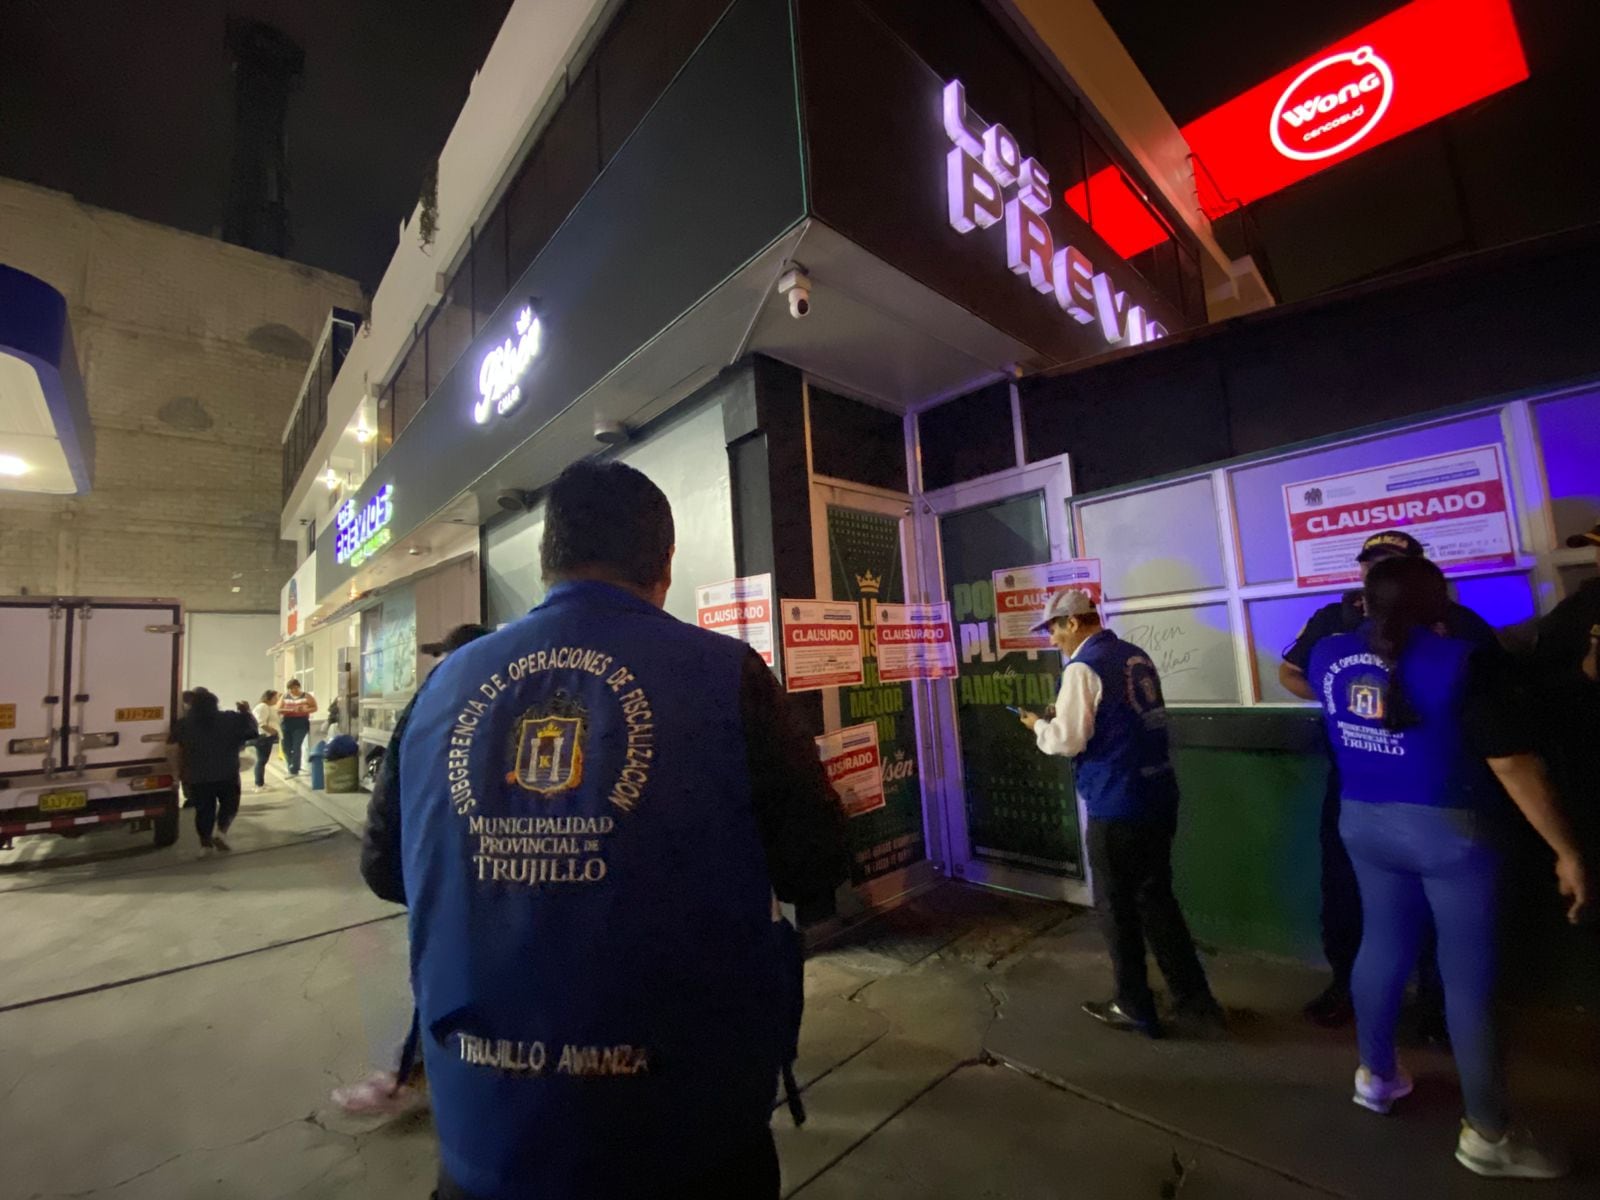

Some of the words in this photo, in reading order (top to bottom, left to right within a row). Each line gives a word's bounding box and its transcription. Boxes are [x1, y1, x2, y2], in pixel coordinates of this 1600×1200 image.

[1303, 104, 1364, 141] cencosud
[943, 79, 1052, 215] LOS
[1306, 490, 1486, 533] CLAUSURADO
[703, 605, 764, 625] CLAUSURADO
[882, 628, 944, 641] CLAUSURADO
[960, 622, 1038, 663] PL
[508, 647, 613, 681] OPERACIONES
[606, 666, 635, 692] DE
[480, 673, 507, 700] DE
[961, 673, 1057, 704] AMISTAD
[849, 687, 904, 718] MEJOR
[449, 700, 488, 815] SUBGERENCIA
[608, 687, 654, 812] FISCALIZACION
[1341, 735, 1405, 756] TRUJILLO
[881, 756, 913, 782] lsen
[469, 815, 614, 834] MUNICIPALIDAD
[480, 836, 579, 854] PROVINCIAL
[584, 840, 599, 851] DE
[473, 855, 608, 886] TRUJILLO
[458, 1032, 547, 1071] TRUJILLO
